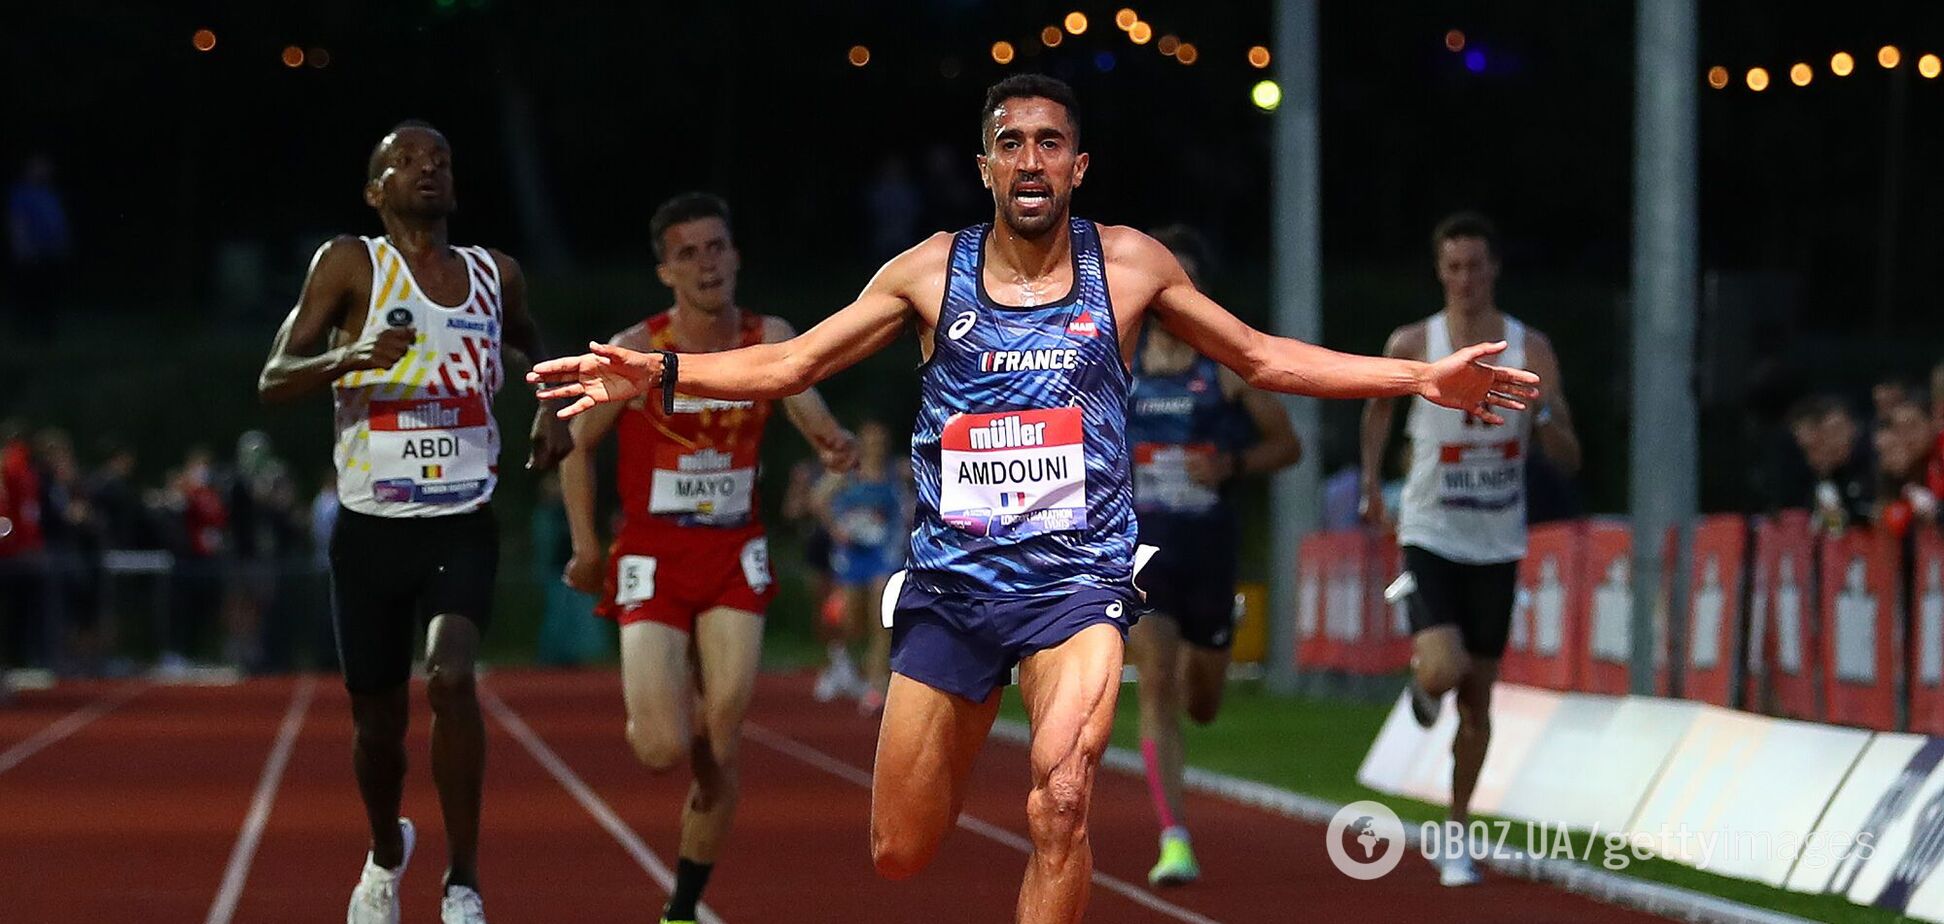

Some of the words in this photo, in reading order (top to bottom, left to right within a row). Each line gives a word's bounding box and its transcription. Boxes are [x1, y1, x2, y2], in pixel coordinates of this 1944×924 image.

[992, 349, 1078, 372] FRANCE
[969, 415, 1047, 450] müller
[402, 436, 459, 459] ABDI
[957, 455, 1069, 485] AMDOUNI
[674, 476, 736, 498] MAYO
[625, 566, 640, 590] 5
